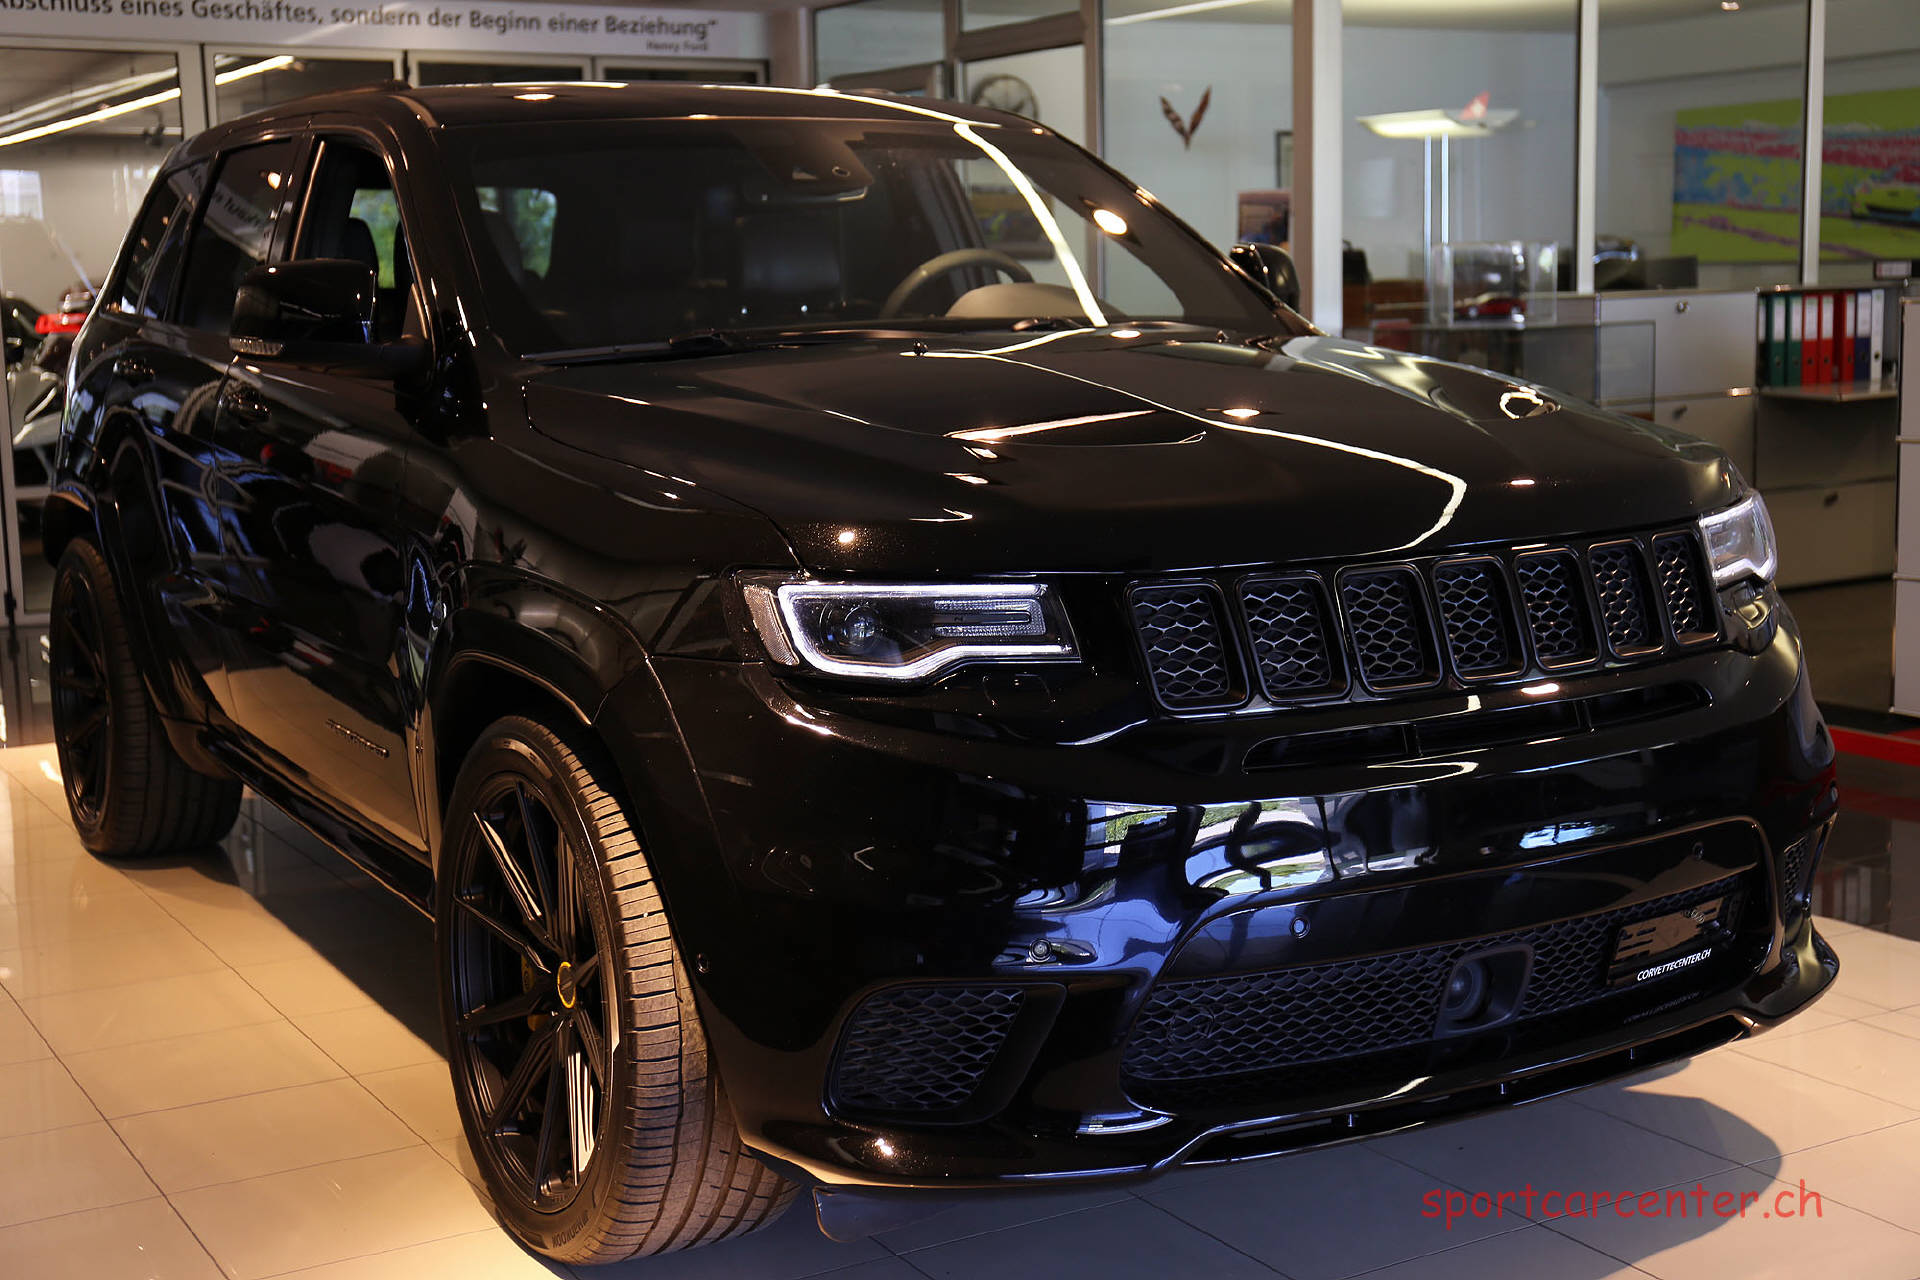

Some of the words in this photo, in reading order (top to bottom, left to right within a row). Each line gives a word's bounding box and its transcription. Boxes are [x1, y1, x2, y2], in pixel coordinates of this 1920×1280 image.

[0, 0, 112, 13] bschluss
[121, 0, 184, 17] eines
[192, 1, 323, 25] Geschäftes,
[331, 5, 421, 26] sondern
[428, 8, 462, 28] der
[470, 10, 542, 34] Beginn
[550, 13, 599, 33] einer
[1637, 948, 1712, 982] CORVETTECENTER.CH
